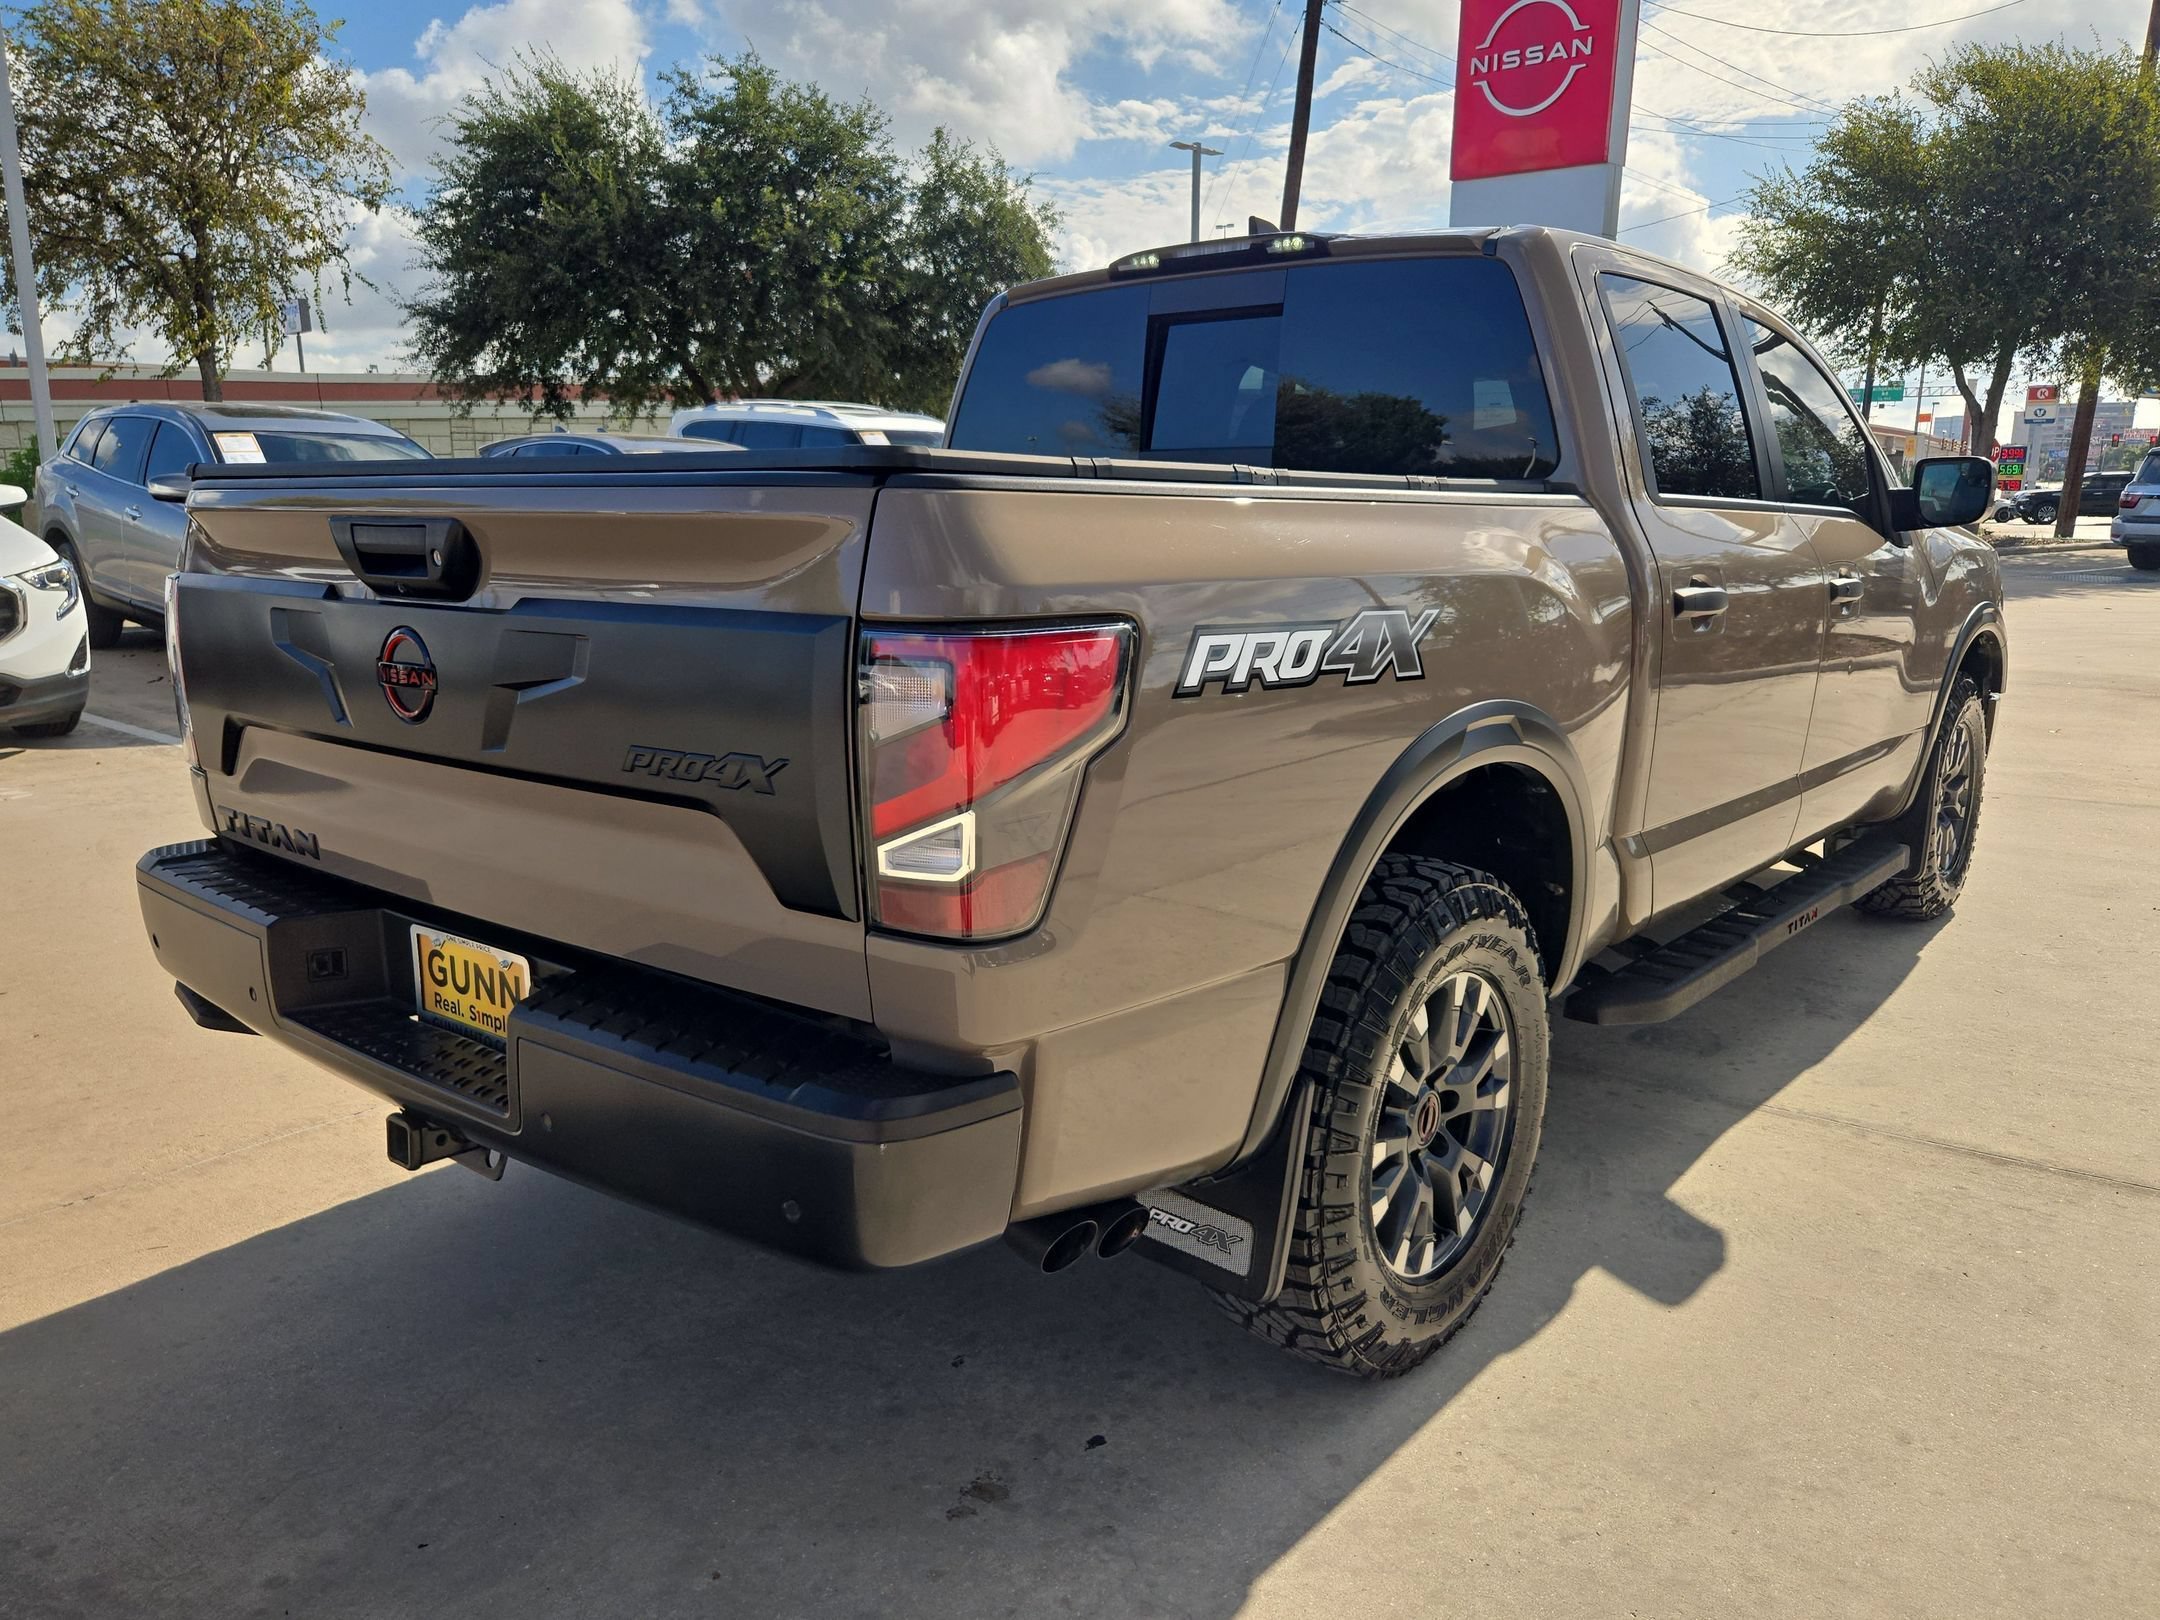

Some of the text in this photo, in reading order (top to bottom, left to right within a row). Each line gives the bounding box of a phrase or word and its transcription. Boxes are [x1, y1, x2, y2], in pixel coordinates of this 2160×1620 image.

[1470, 36, 1593, 76] NISSAN
[379, 664, 434, 687] NISSAN
[217, 804, 321, 861] TITAN
[1786, 907, 1819, 935] TITAN
[427, 949, 520, 1009] GUNN
[1392, 934, 1532, 1050] GOODYEAR
[434, 992, 465, 1018] Real.
